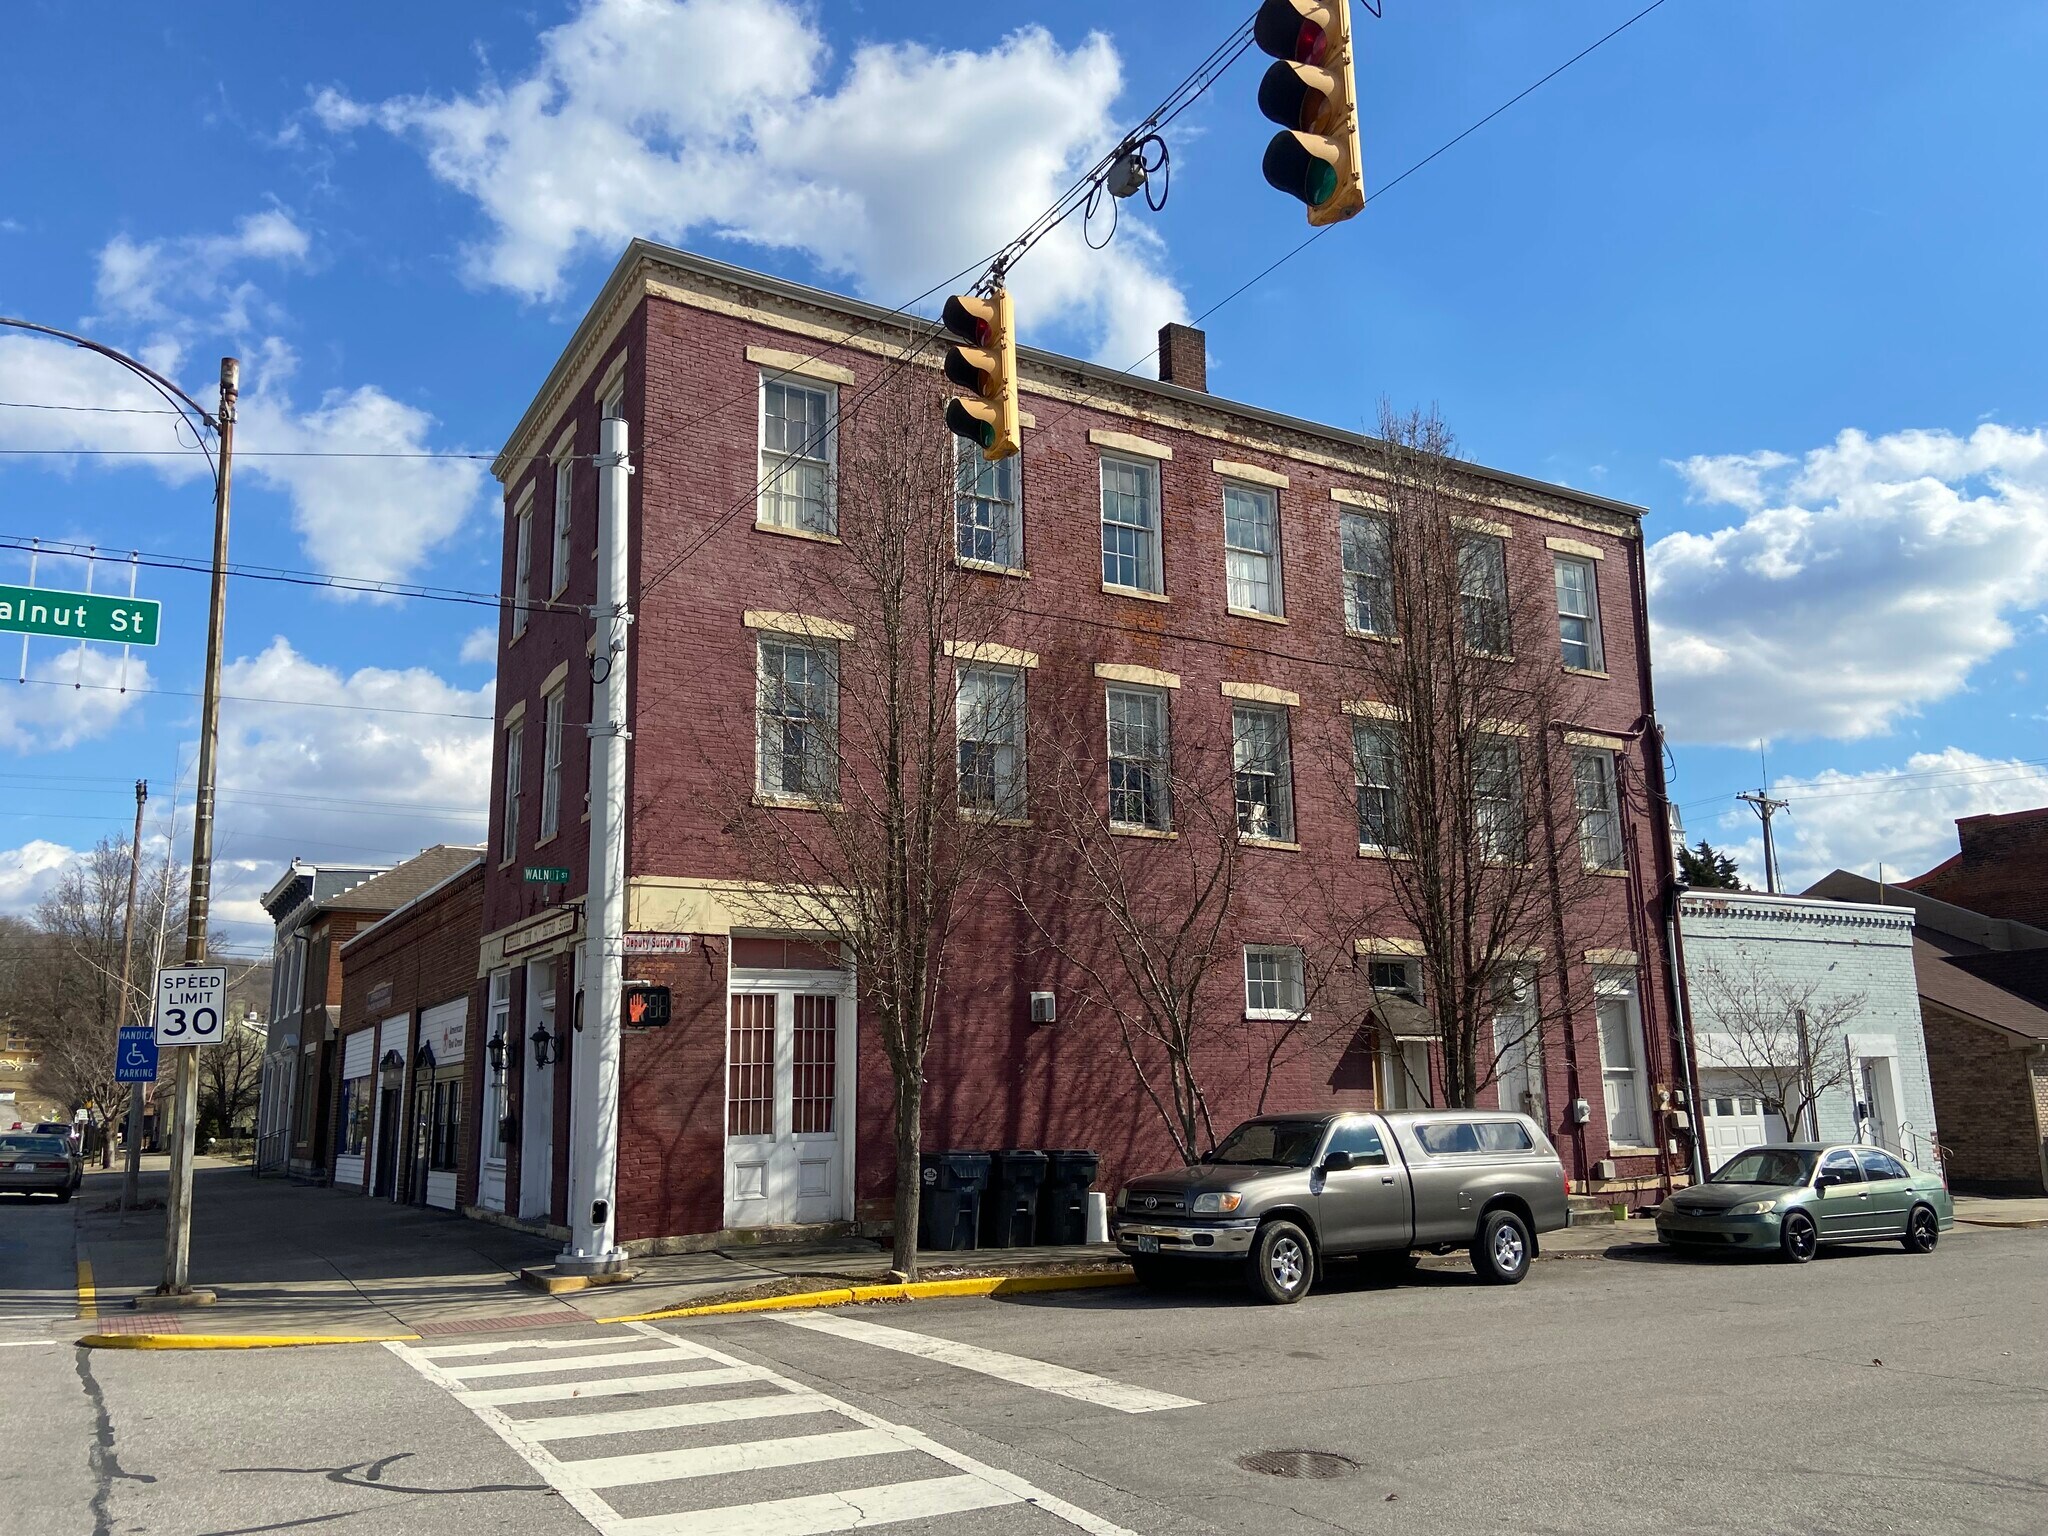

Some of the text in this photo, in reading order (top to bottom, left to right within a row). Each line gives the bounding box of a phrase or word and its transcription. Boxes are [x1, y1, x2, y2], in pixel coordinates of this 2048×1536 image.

[110, 609, 143, 634] St
[525, 868, 568, 881] WALNUT ST
[625, 936, 688, 951] Deputy Sutton Way
[164, 976, 221, 989] SPEED
[169, 992, 214, 1005] LIMIT
[163, 1007, 218, 1036] 30
[120, 1030, 155, 1040] HANDICA
[119, 1068, 154, 1078] PARKING
